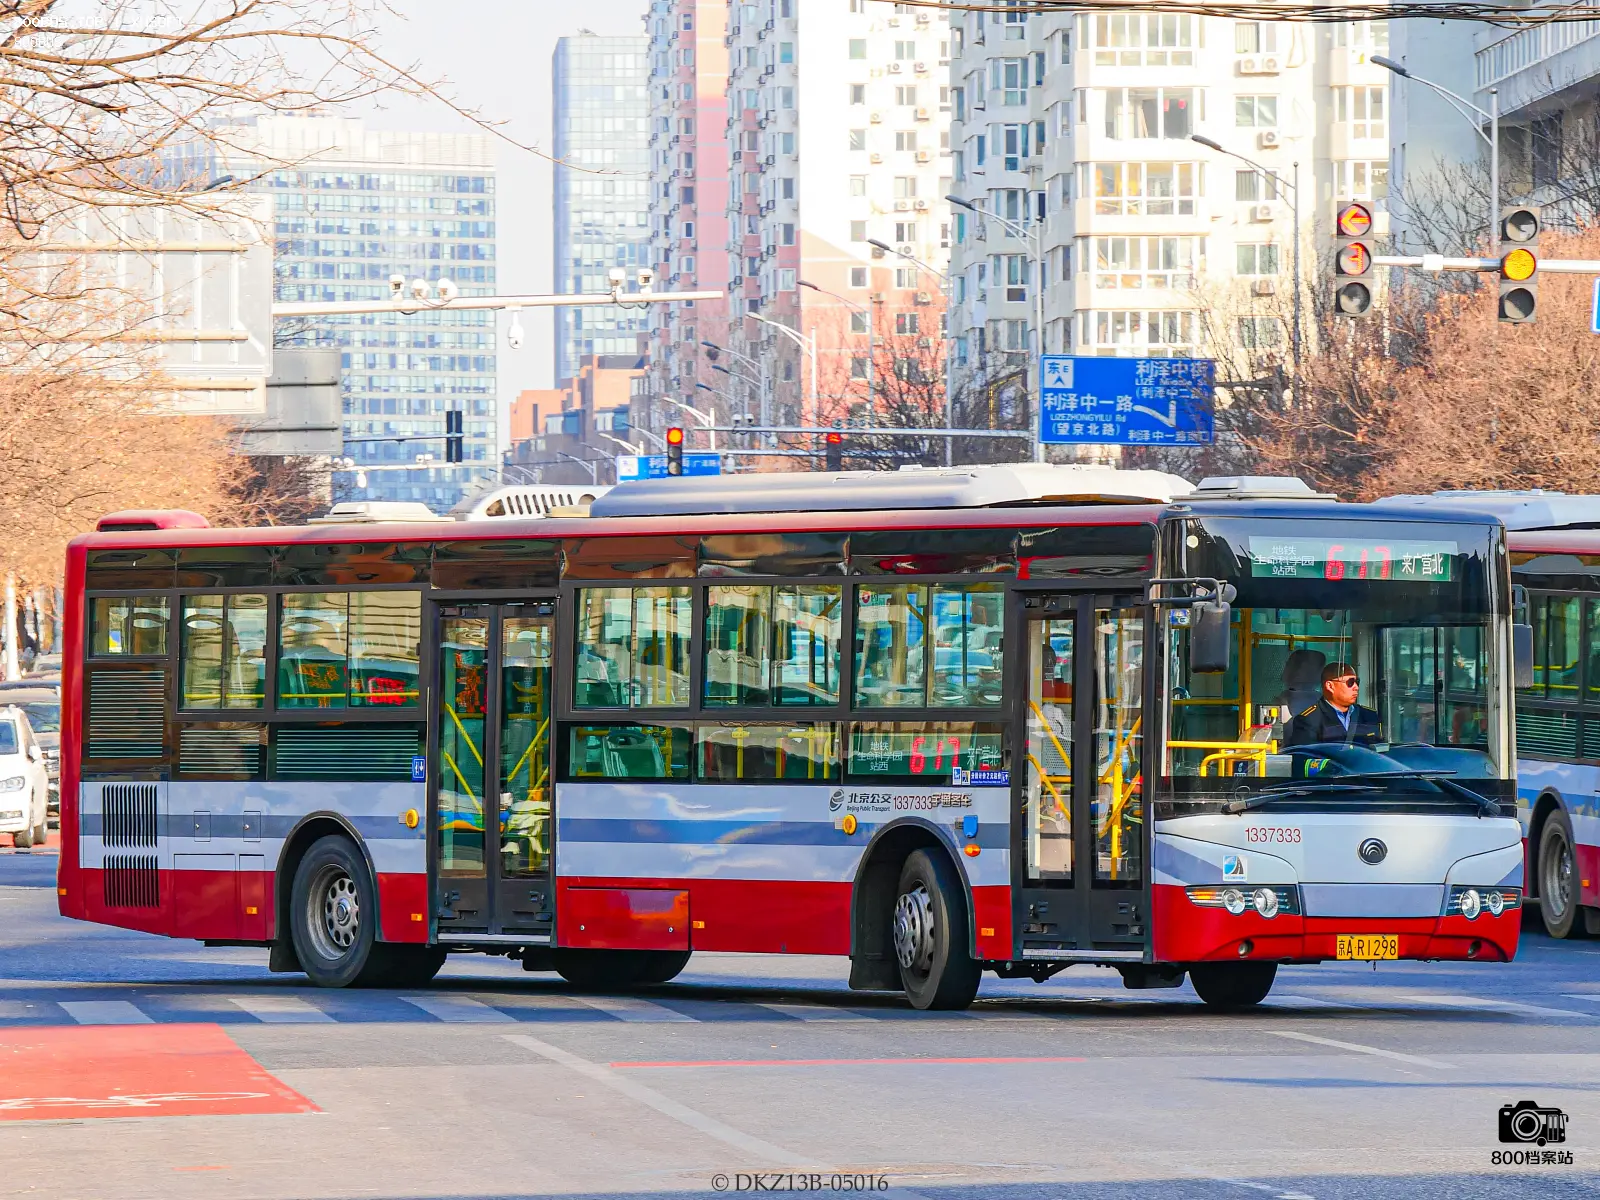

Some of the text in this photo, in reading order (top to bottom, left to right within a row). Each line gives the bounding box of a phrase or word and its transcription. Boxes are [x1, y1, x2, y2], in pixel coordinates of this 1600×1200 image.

[1047, 362, 1069, 374] 东 E
[1044, 392, 1133, 412] 利泽中一路
[1271, 545, 1296, 556] 地铁
[1253, 555, 1315, 567] 生命科学园
[1324, 545, 1392, 580] 617
[1401, 552, 1443, 575] 来广营北
[1271, 565, 1297, 576] 站西
[870, 740, 888, 750] 地铁
[857, 751, 902, 761] 生命科学园
[910, 736, 961, 774] 617
[870, 762, 888, 771] 站西
[848, 793, 892, 803] 北京公交
[893, 796, 932, 810] 1337333
[1245, 827, 1301, 843] 1337333
